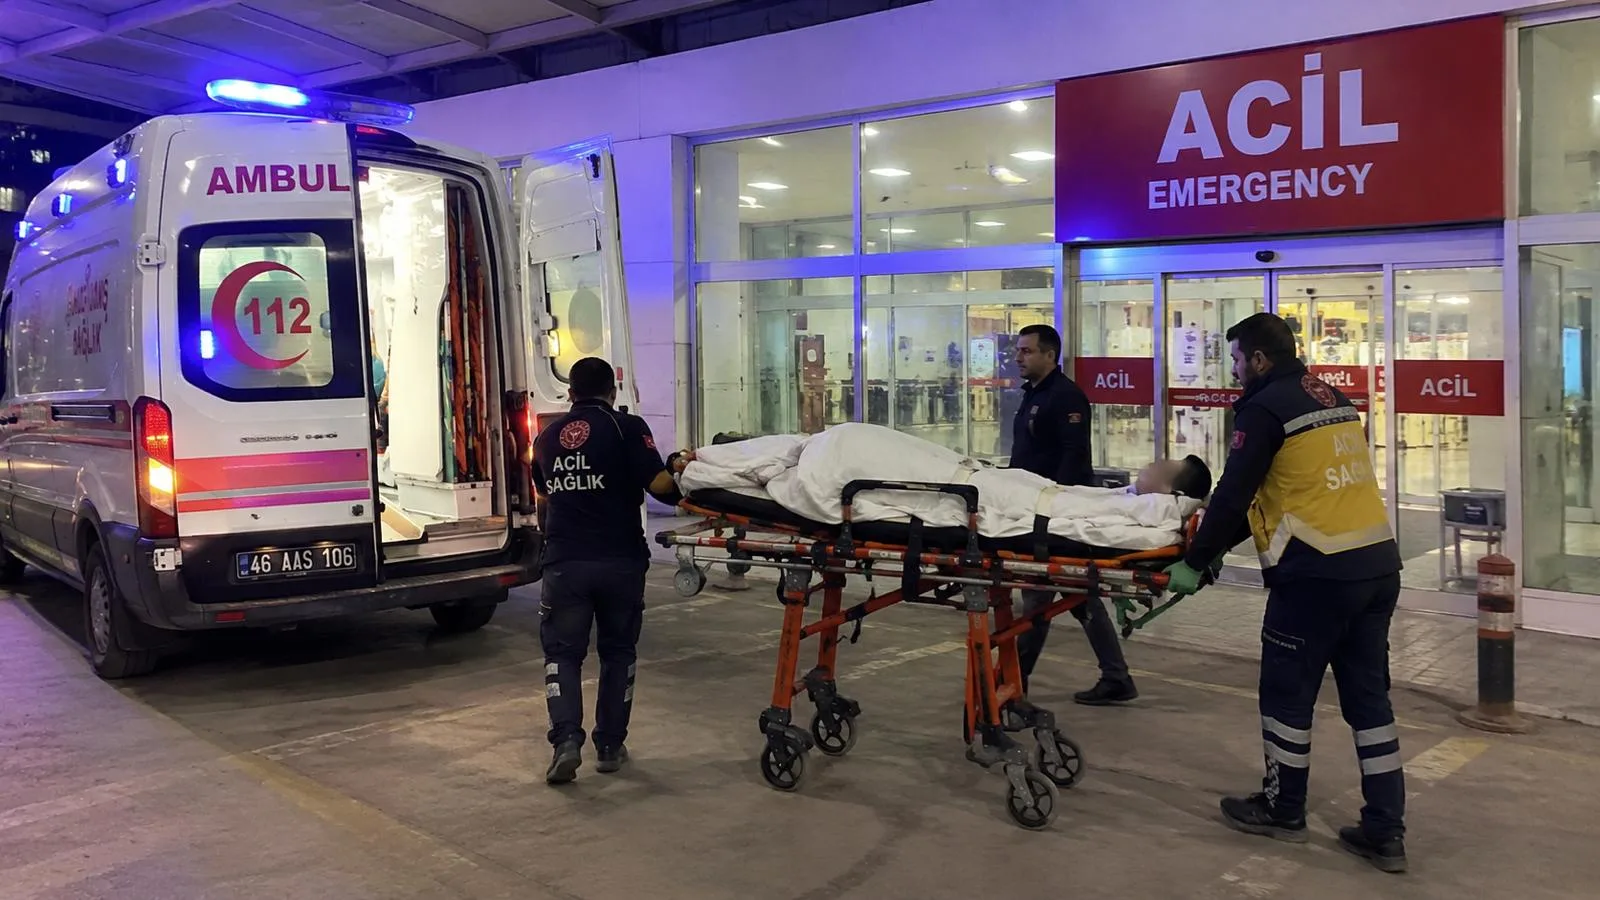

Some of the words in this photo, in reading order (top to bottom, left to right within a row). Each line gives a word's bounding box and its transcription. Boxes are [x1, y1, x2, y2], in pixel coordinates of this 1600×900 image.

[1156, 52, 1399, 164] ACİL
[206, 163, 350, 196] AMBUL
[1147, 162, 1374, 210] EMERGENCY
[243, 296, 312, 335] 112
[1094, 369, 1136, 389] ACİL
[1419, 373, 1478, 397] ACİL
[552, 451, 592, 473] ACİL
[545, 472, 606, 495] SAĞLIK
[250, 553, 272, 575] 46
[281, 549, 313, 572] AAS
[322, 546, 354, 568] 106
